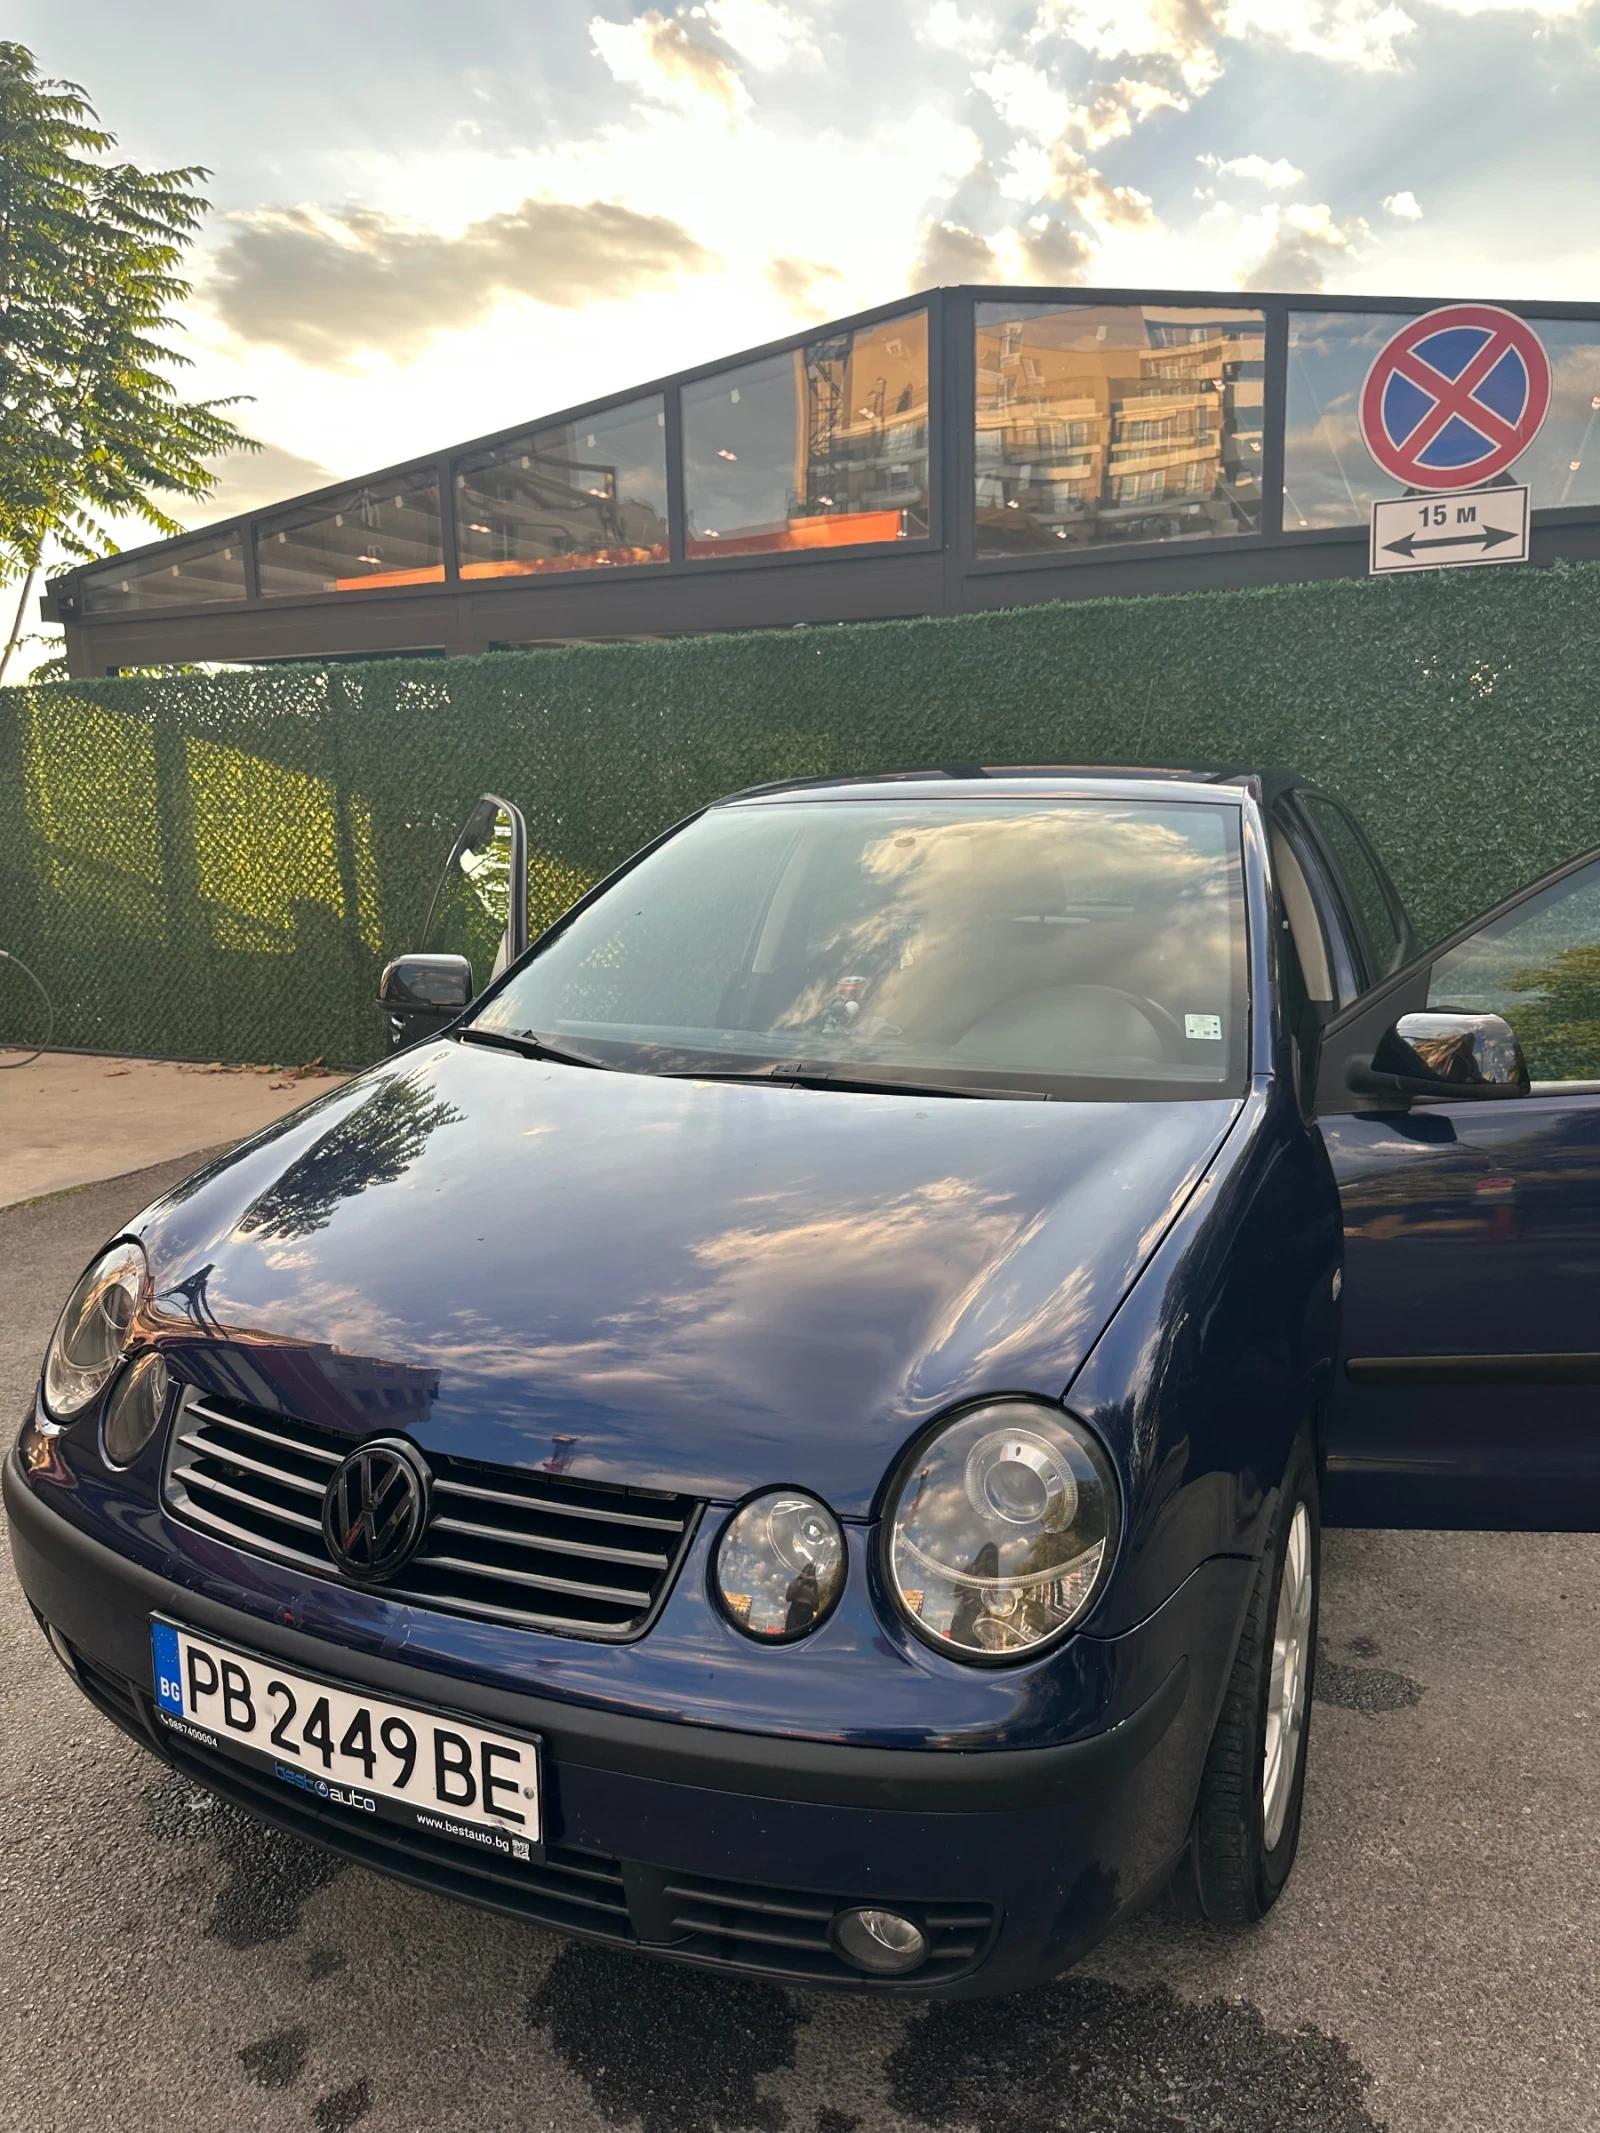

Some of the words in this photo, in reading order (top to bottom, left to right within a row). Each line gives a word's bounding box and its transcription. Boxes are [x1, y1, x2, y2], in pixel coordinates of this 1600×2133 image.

[1418, 504, 1447, 527] 15
[160, 1676, 180, 1702] BG
[186, 1645, 256, 1732] PB
[267, 1680, 417, 1789] 2449
[434, 1727, 526, 1825] BE
[329, 1788, 376, 1812] auto
[416, 1813, 510, 1853] www.bestauto.bg
